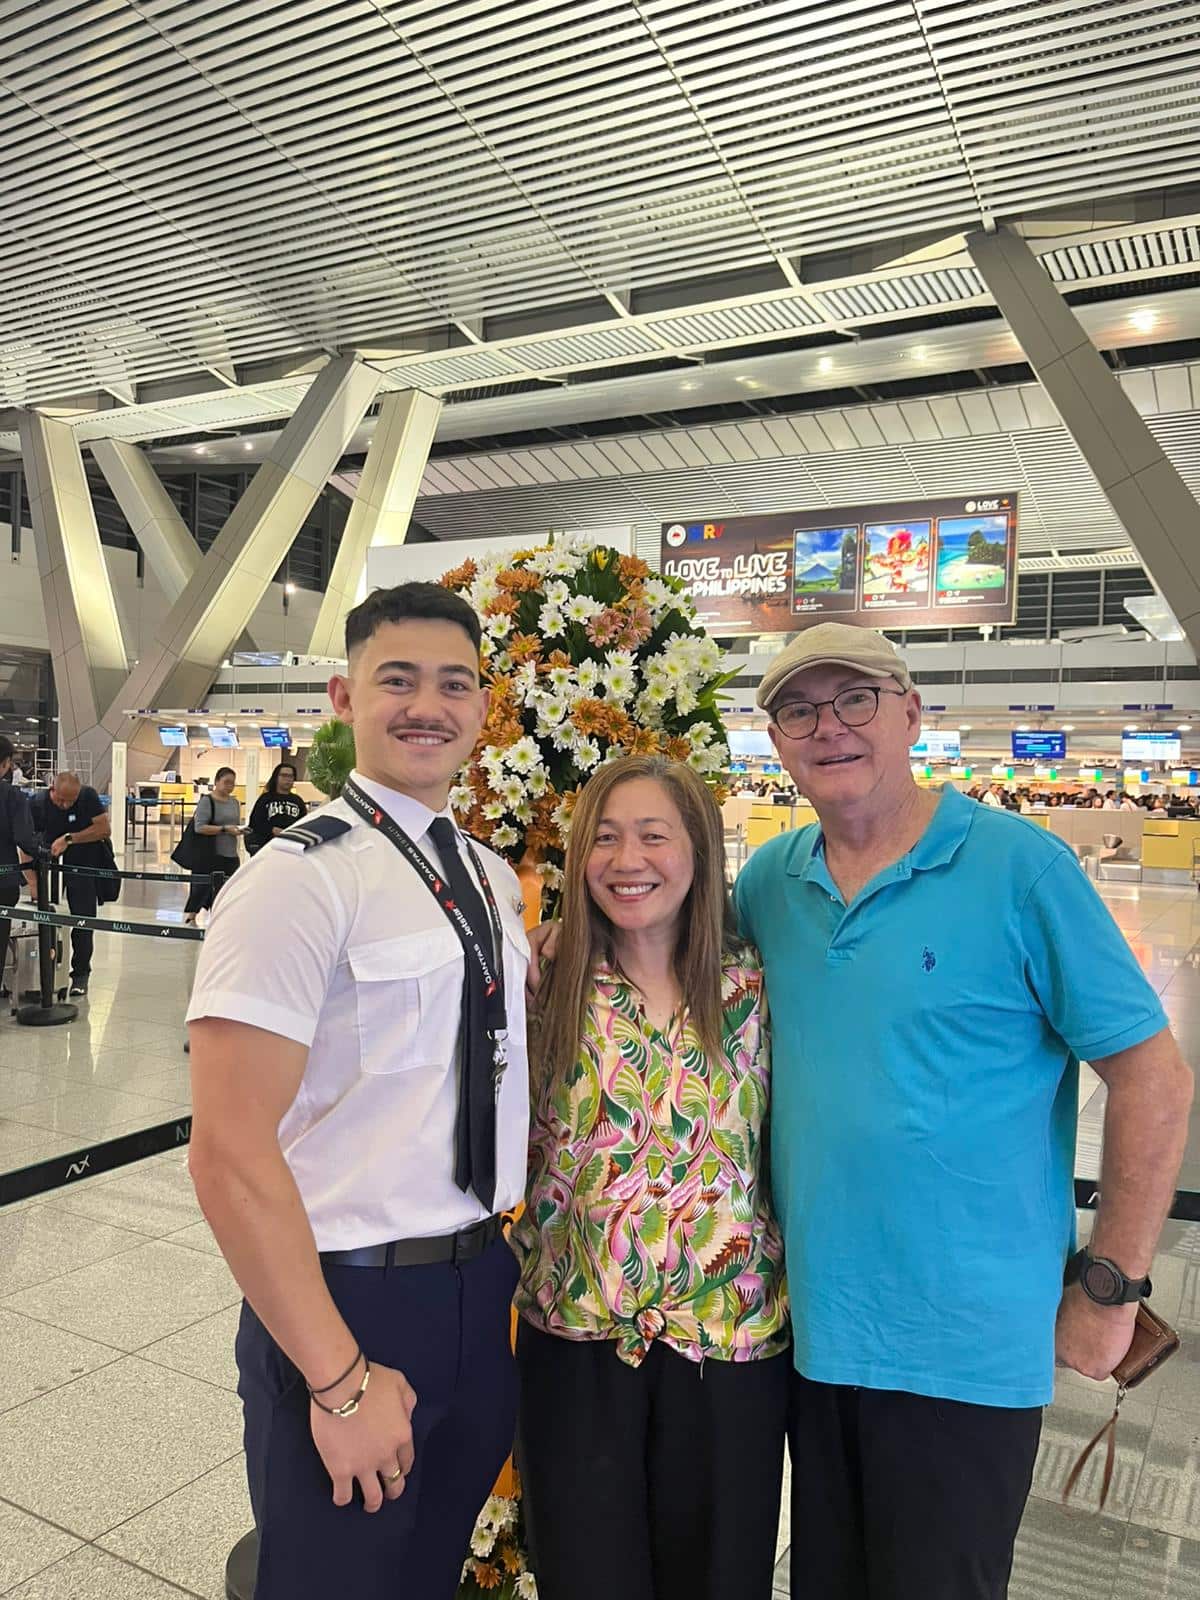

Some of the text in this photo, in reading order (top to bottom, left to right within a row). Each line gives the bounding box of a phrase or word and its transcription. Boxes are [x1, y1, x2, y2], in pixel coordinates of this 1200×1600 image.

[664, 556, 720, 580] LOVE
[733, 552, 787, 578] LIVE
[692, 575, 787, 597] PHILIPPINES
[408, 847, 436, 881] QANTAS
[33, 912, 50, 922] NAIA
[113, 922, 132, 932] NAIA
[453, 907, 474, 936] Jetstar
[473, 943, 492, 984] QANTAS
